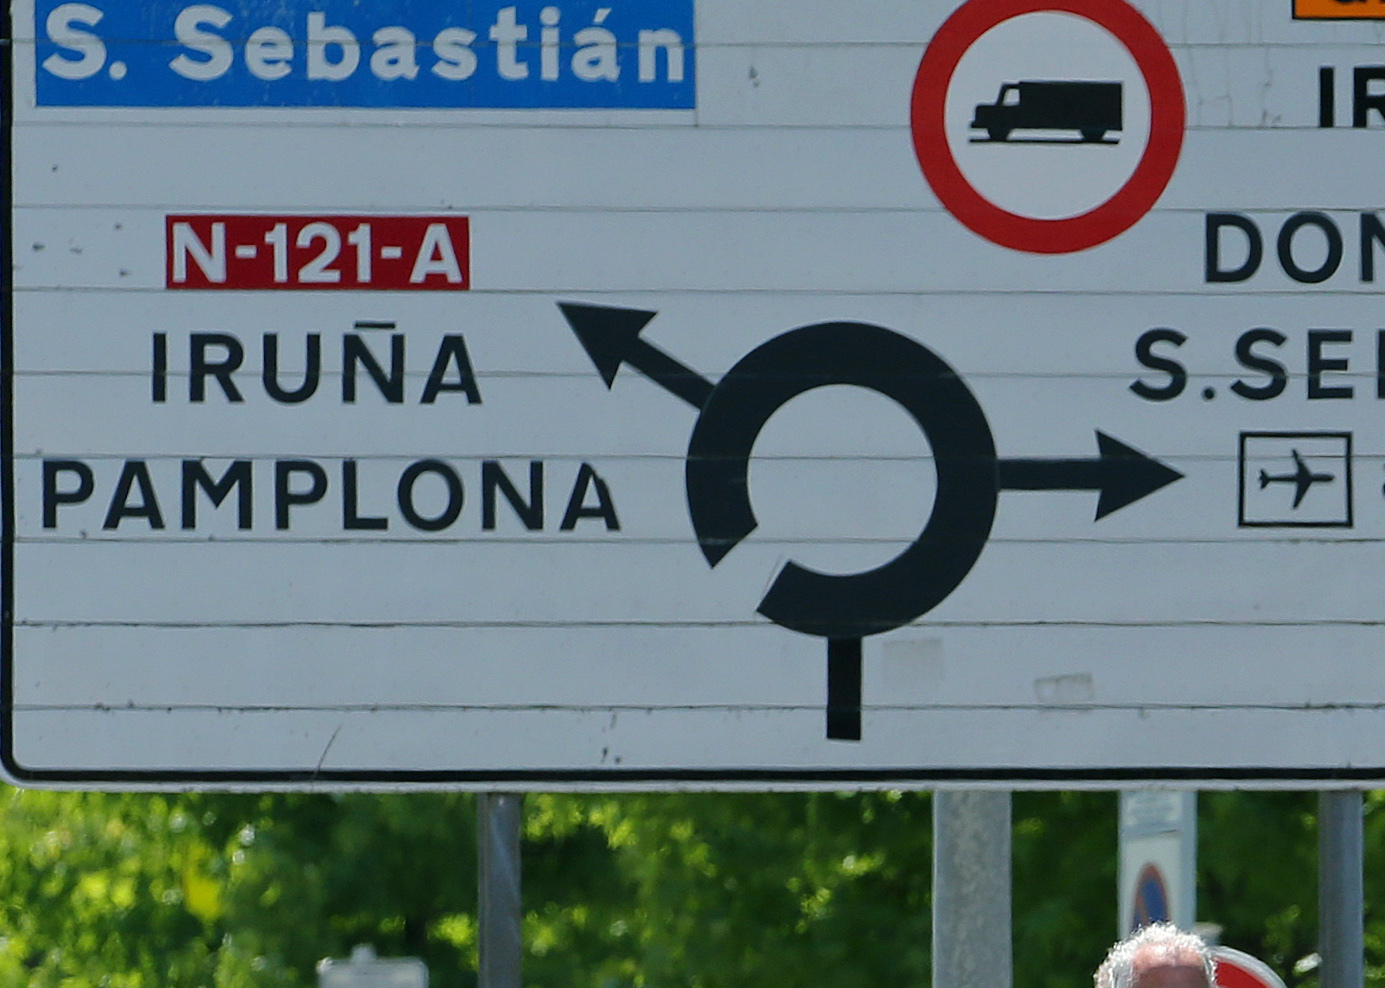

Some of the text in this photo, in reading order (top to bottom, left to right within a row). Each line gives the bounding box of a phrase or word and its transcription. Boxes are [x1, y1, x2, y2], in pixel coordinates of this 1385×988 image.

[42, 2, 685, 83] S. Sebastián
[172, 221, 463, 283] N-121-A
[152, 321, 483, 405] IRUÑA
[42, 455, 621, 532] PAMPLONA
